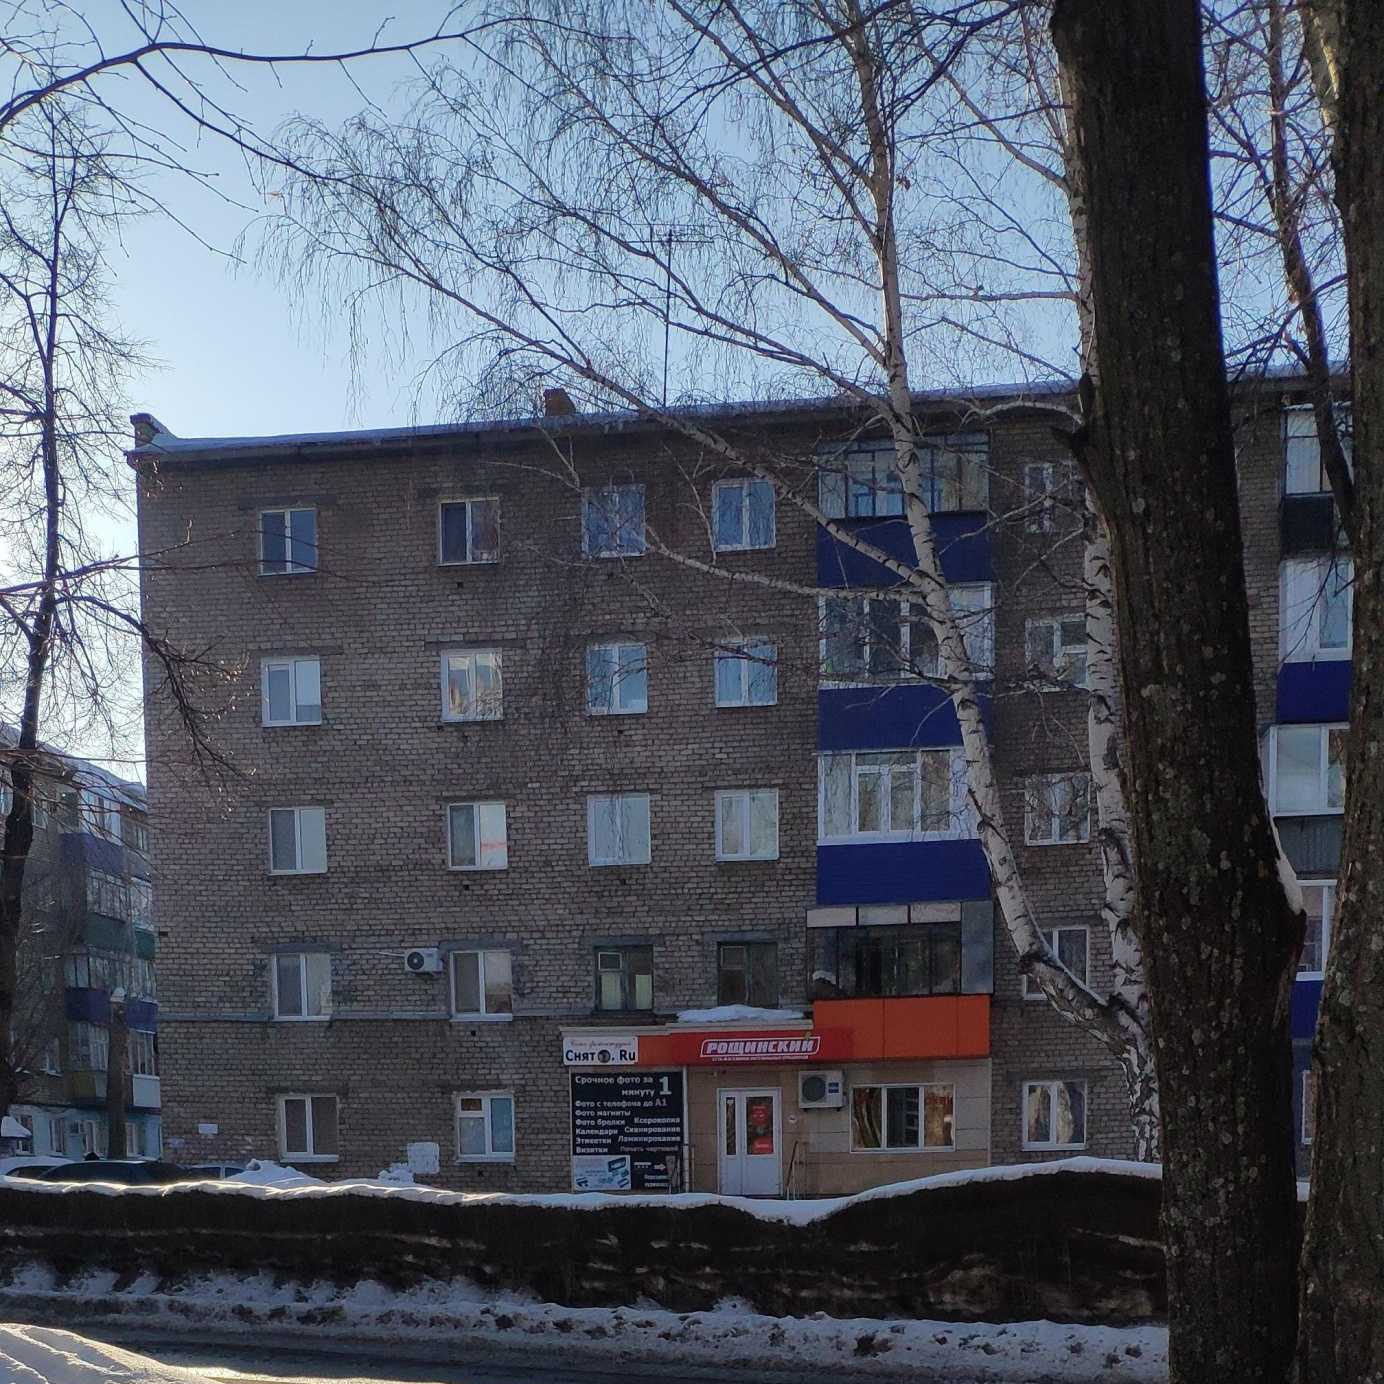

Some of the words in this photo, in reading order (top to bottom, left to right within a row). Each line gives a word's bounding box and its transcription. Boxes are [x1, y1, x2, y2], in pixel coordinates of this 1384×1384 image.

[575, 1076, 614, 1085] Срочное
[616, 1076, 641, 1085] фото
[658, 1075, 672, 1095] 1
[621, 1089, 655, 1097] минуту
[603, 1100, 641, 1108] телефона
[575, 1109, 595, 1117] Фото
[575, 1118, 595, 1126] Фото
[575, 1127, 618, 1136] Календари
[575, 1146, 608, 1154] Визитки
